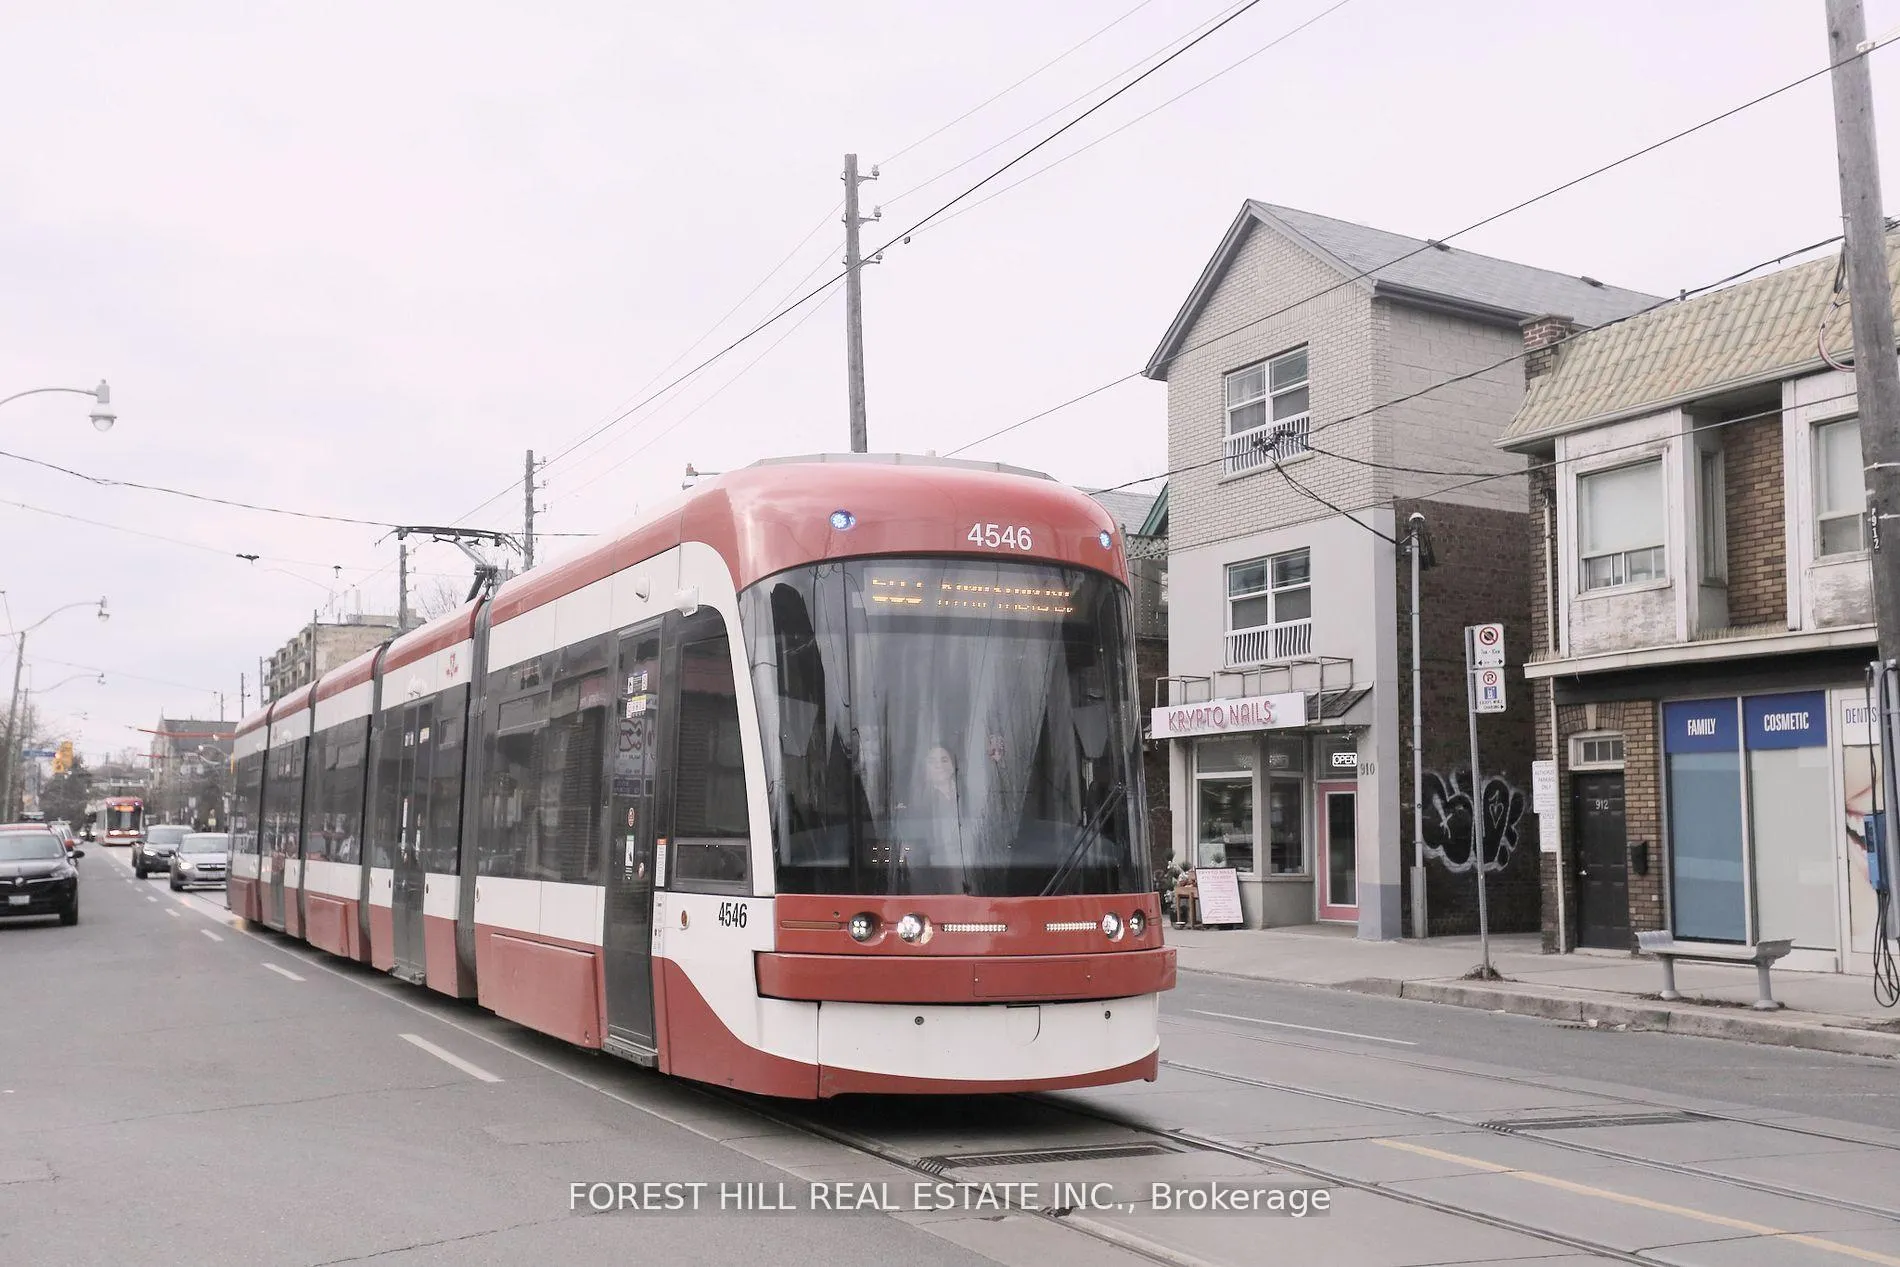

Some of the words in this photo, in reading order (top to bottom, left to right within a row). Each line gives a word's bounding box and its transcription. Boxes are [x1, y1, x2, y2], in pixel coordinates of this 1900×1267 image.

[967, 522, 1032, 551] 4546
[1168, 706, 1226, 732] KRYPTO
[1229, 700, 1274, 727] NAILS
[1763, 711, 1810, 732] COSMETIC
[1687, 718, 1716, 736] FAMILY
[1334, 755, 1357, 765] OPEN
[1360, 762, 1375, 776] 910
[1595, 799, 1609, 810] 912
[718, 901, 748, 929] 4546
